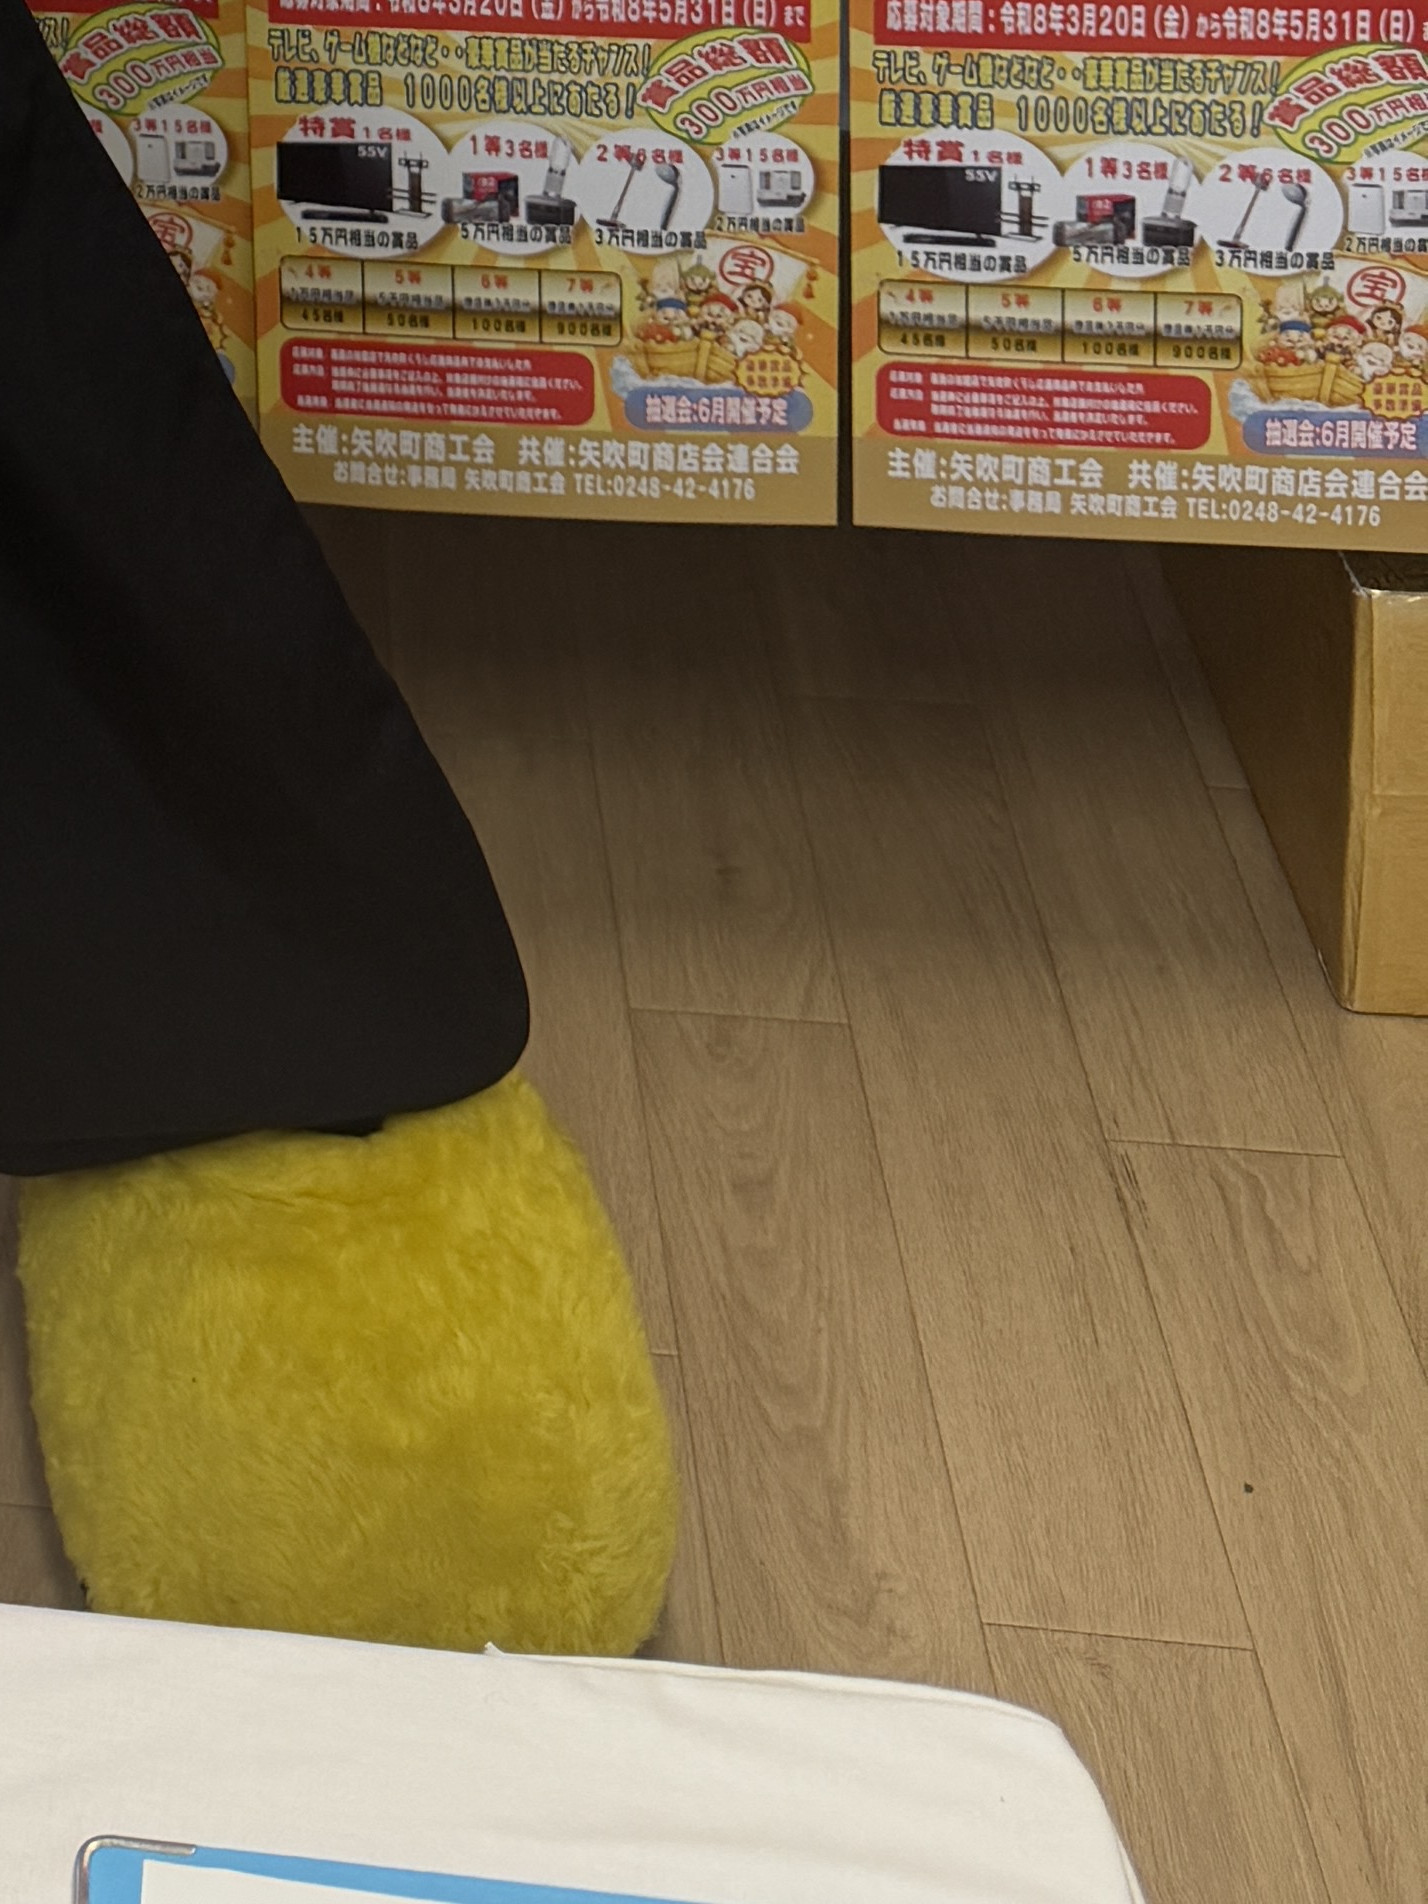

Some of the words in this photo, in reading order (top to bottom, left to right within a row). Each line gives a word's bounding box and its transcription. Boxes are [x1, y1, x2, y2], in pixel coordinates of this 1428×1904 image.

[518, 435, 801, 474] 共催:矢吹町商店会連合会
[574, 472, 757, 501] TEL:0248-42-4176
[887, 447, 1104, 488] 主催:矢吹町商工会
[1127, 458, 1428, 502] 共催:矢吹町商店会連合会
[1186, 496, 1381, 527] TEL:0248-42-4176
